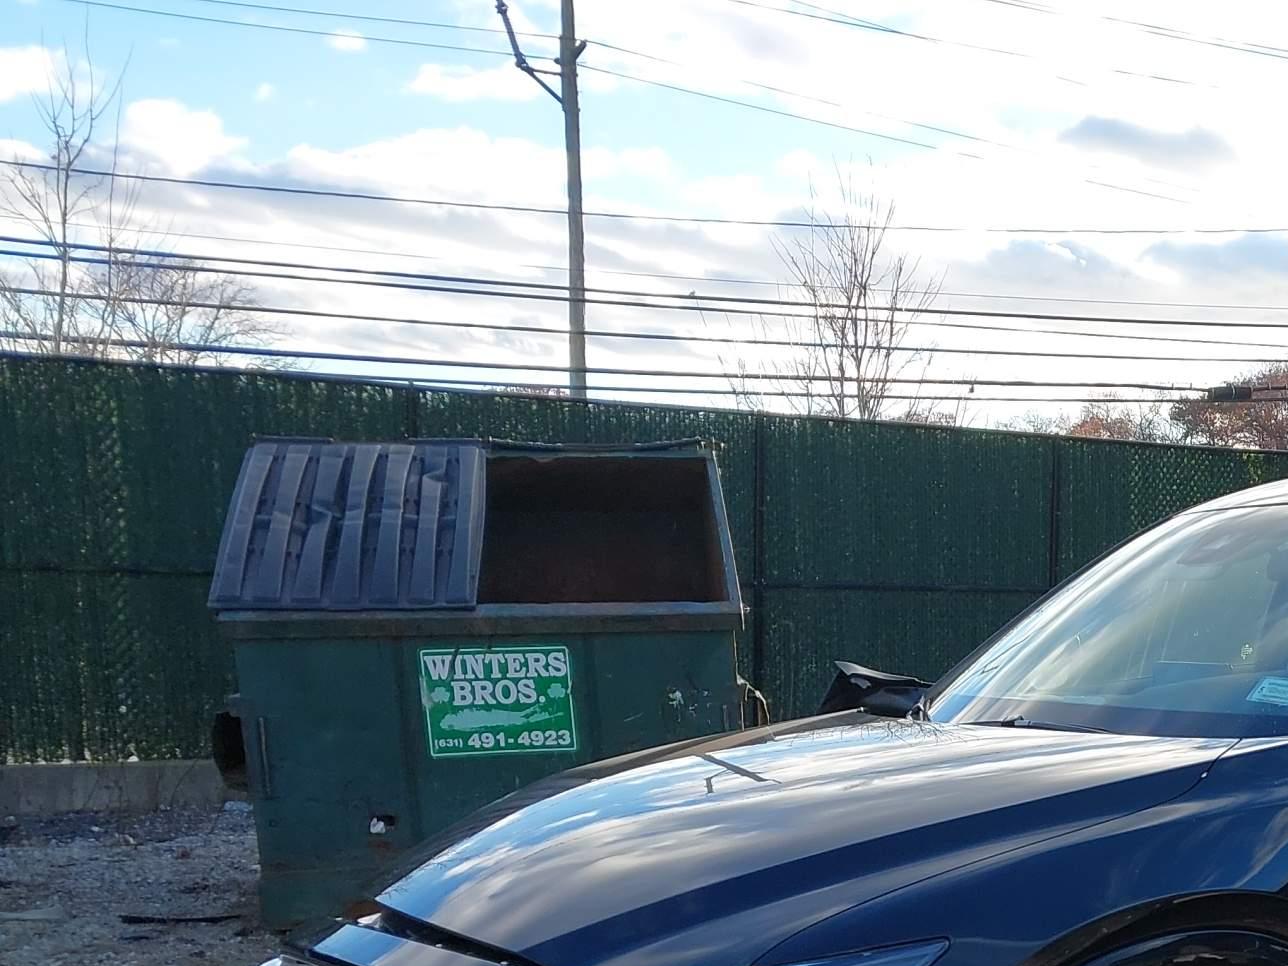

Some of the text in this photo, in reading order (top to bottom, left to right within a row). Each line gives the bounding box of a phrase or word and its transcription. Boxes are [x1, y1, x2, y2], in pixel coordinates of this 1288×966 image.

[424, 652, 567, 681] WINTERS
[451, 679, 546, 705] BROS.
[434, 730, 571, 750] (631) 491-4923
